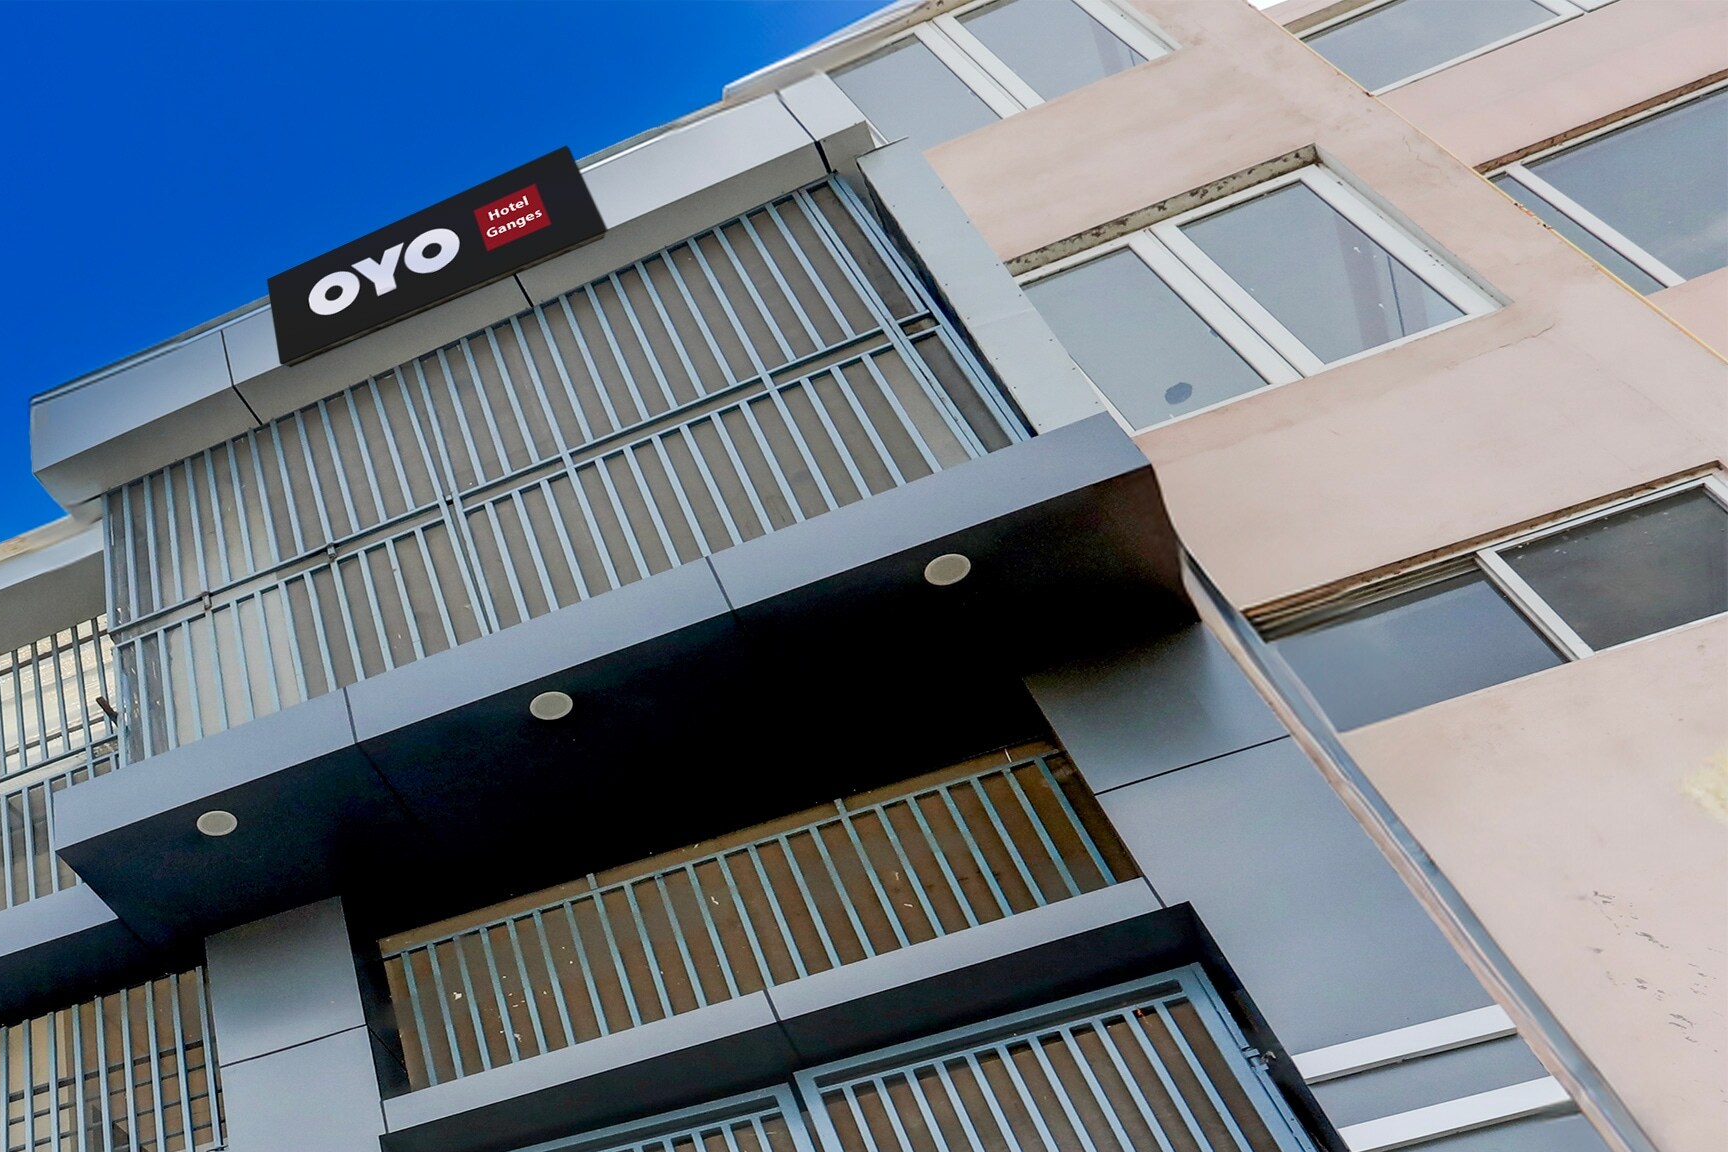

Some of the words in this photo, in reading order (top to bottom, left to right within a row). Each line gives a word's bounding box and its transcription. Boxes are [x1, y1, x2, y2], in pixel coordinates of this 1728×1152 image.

[485, 208, 543, 239] Ganges
[487, 196, 530, 221] Hotel
[308, 228, 460, 316] OYO
